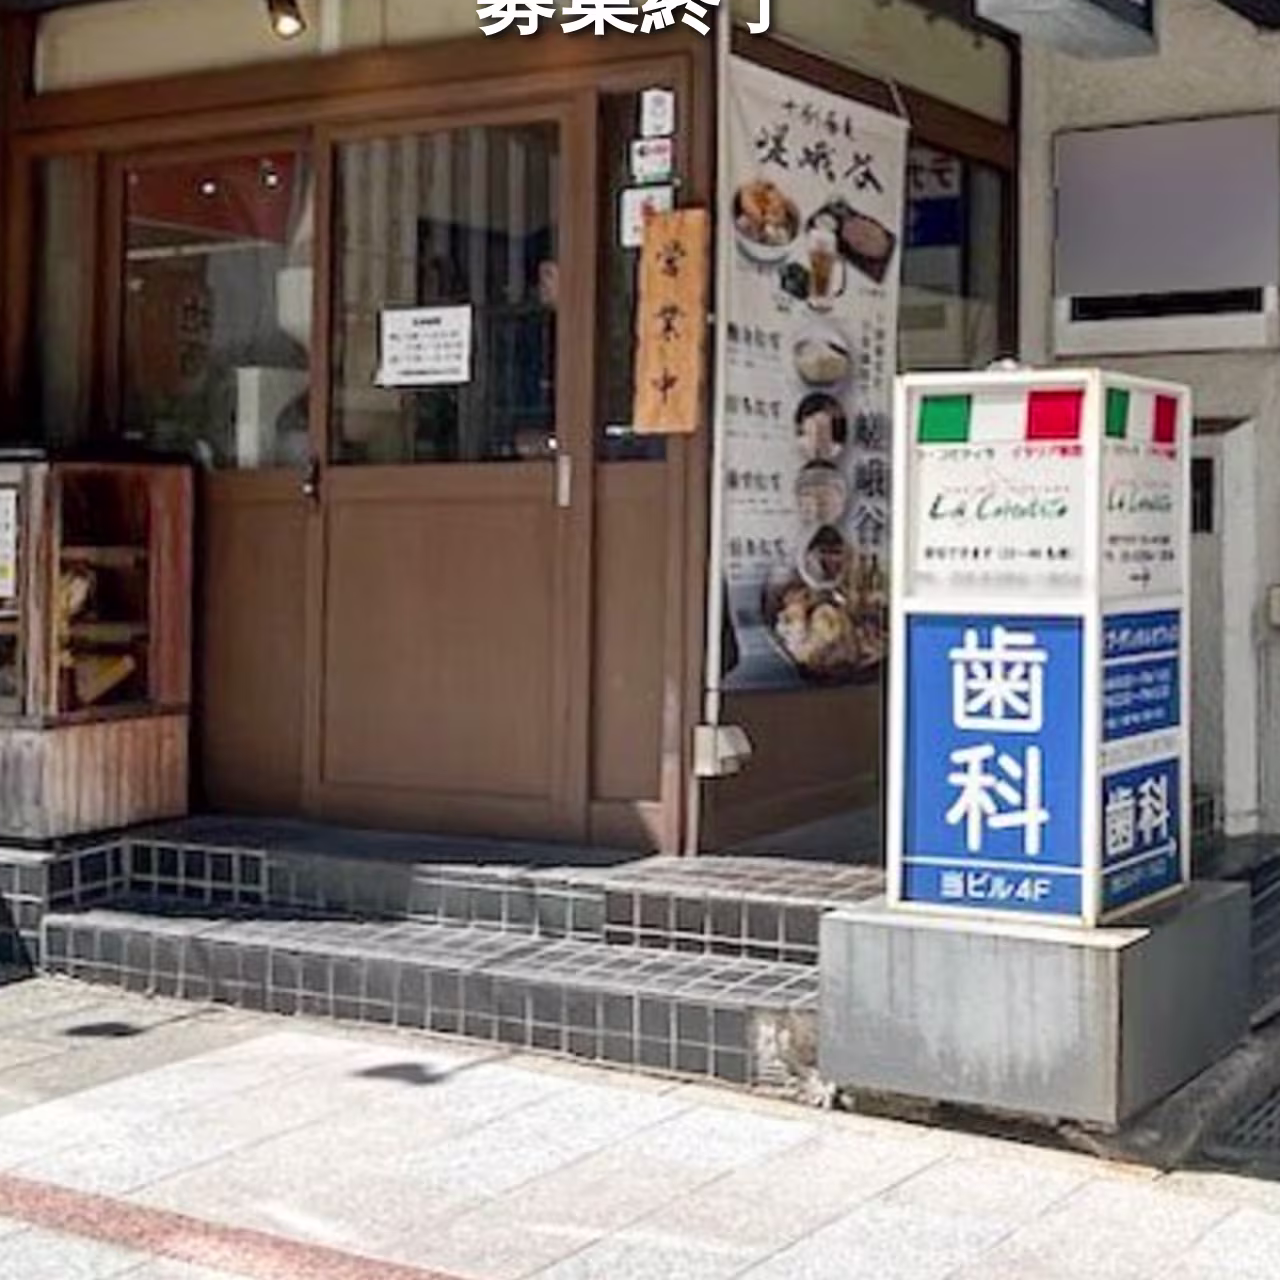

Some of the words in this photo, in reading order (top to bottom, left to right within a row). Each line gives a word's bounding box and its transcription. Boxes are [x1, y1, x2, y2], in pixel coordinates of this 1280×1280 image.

[650, 239, 686, 407] 営業中
[946, 625, 1050, 857] 歯科
[1105, 774, 1171, 857] 歯科
[939, 872, 1052, 903] 当ビル4F
